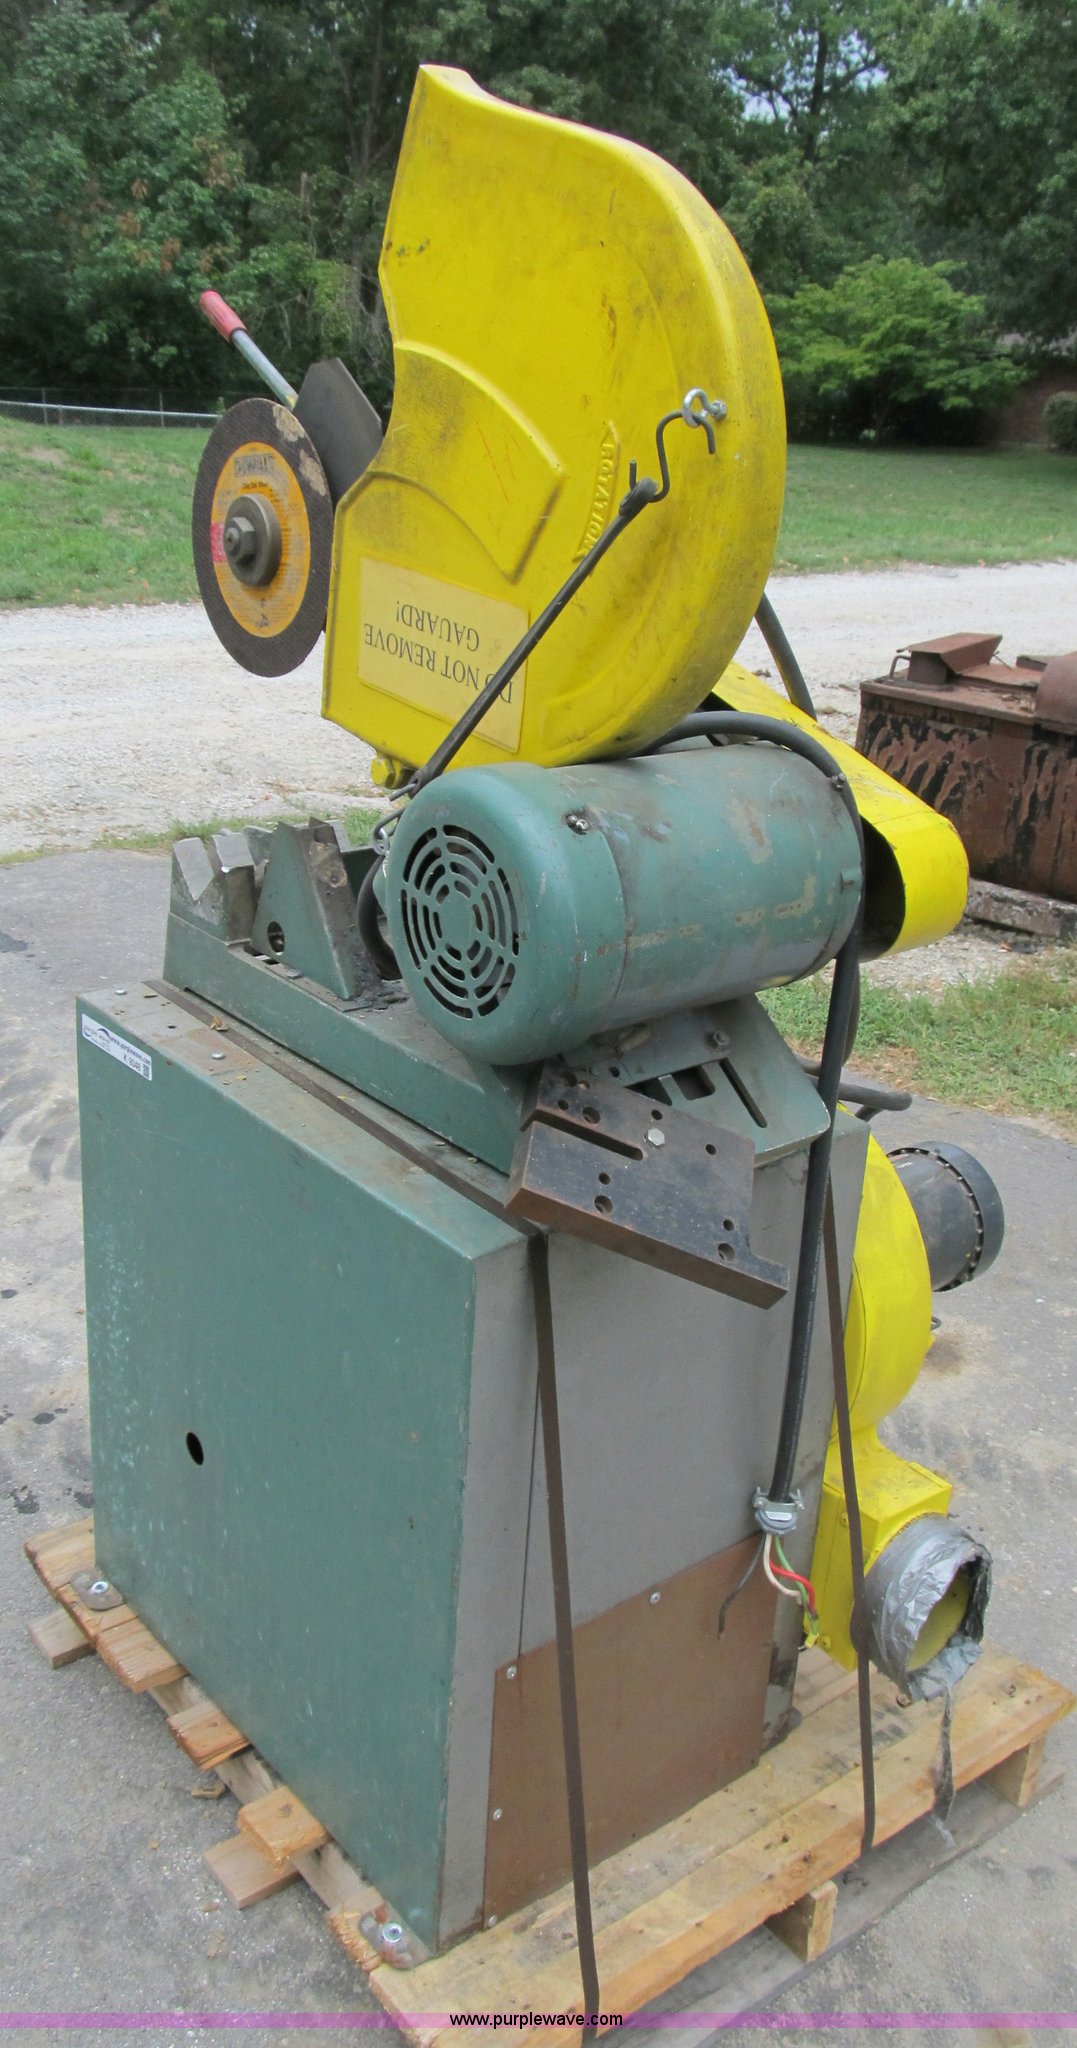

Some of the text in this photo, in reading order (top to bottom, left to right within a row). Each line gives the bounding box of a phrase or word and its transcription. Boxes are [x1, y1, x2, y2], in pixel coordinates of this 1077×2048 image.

[364, 623, 436, 672] REMOVE
[395, 601, 480, 651] GAUARD!
[441, 655, 480, 690] NOT
